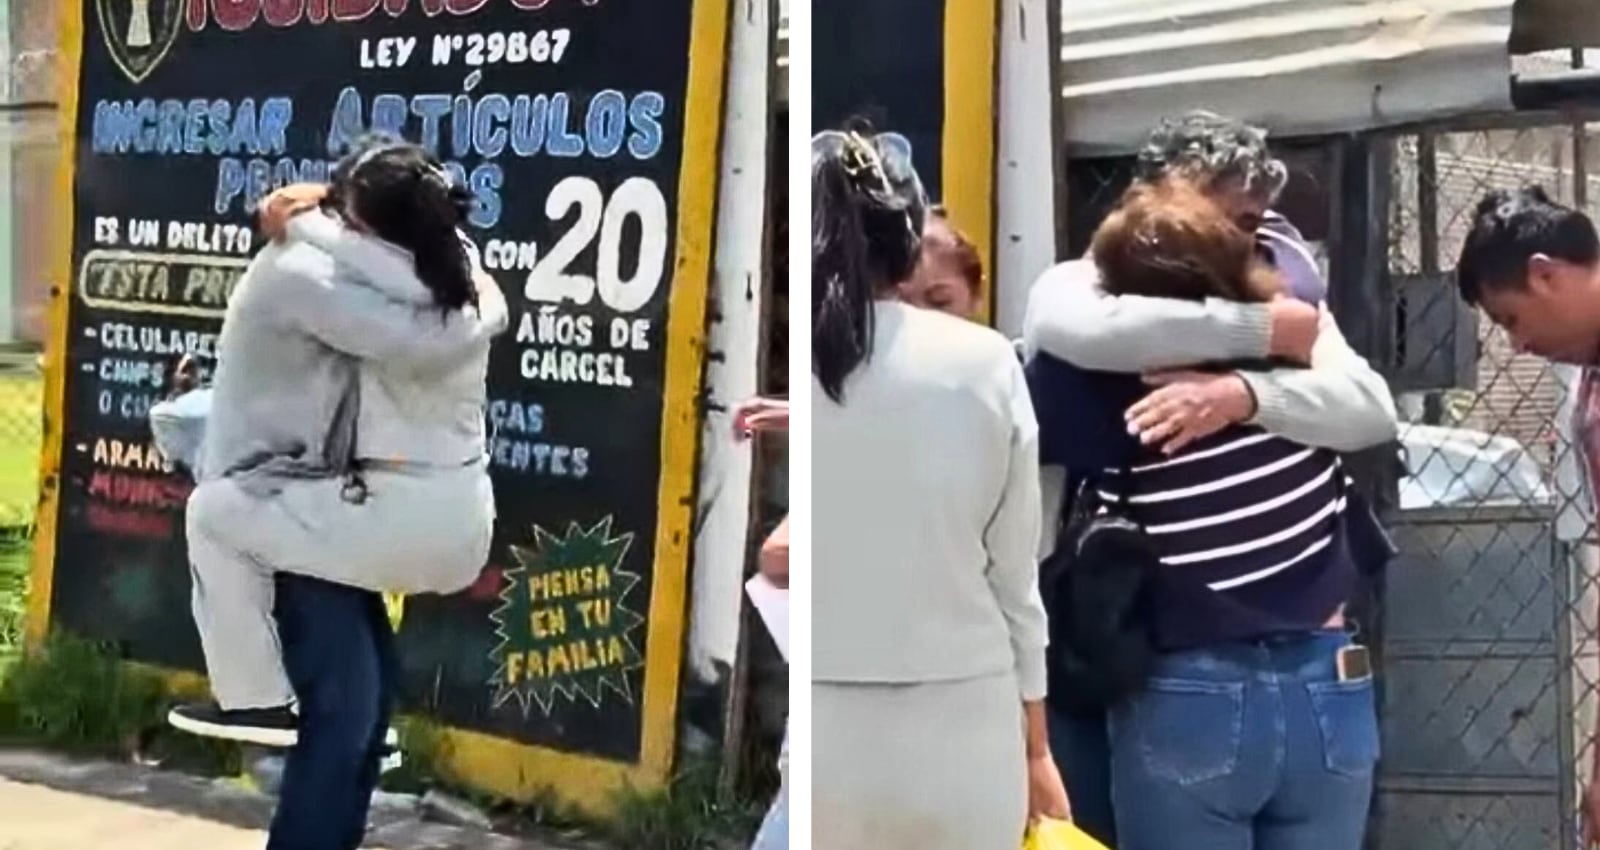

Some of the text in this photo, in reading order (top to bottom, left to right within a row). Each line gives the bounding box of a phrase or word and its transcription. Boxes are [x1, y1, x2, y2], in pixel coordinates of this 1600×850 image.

[360, 37, 416, 68] LEY
[93, 98, 292, 154] INGRESAR
[94, 216, 252, 253] ES UN DELITO
[484, 176, 668, 312] CON 20
[101, 322, 221, 357] CELULARE
[516, 305, 650, 350] AÑOS DE
[493, 438, 589, 477] ENTES
[528, 564, 611, 600] PIENSA
[530, 599, 612, 639] EN TU
[507, 635, 625, 684] FAMILIA
